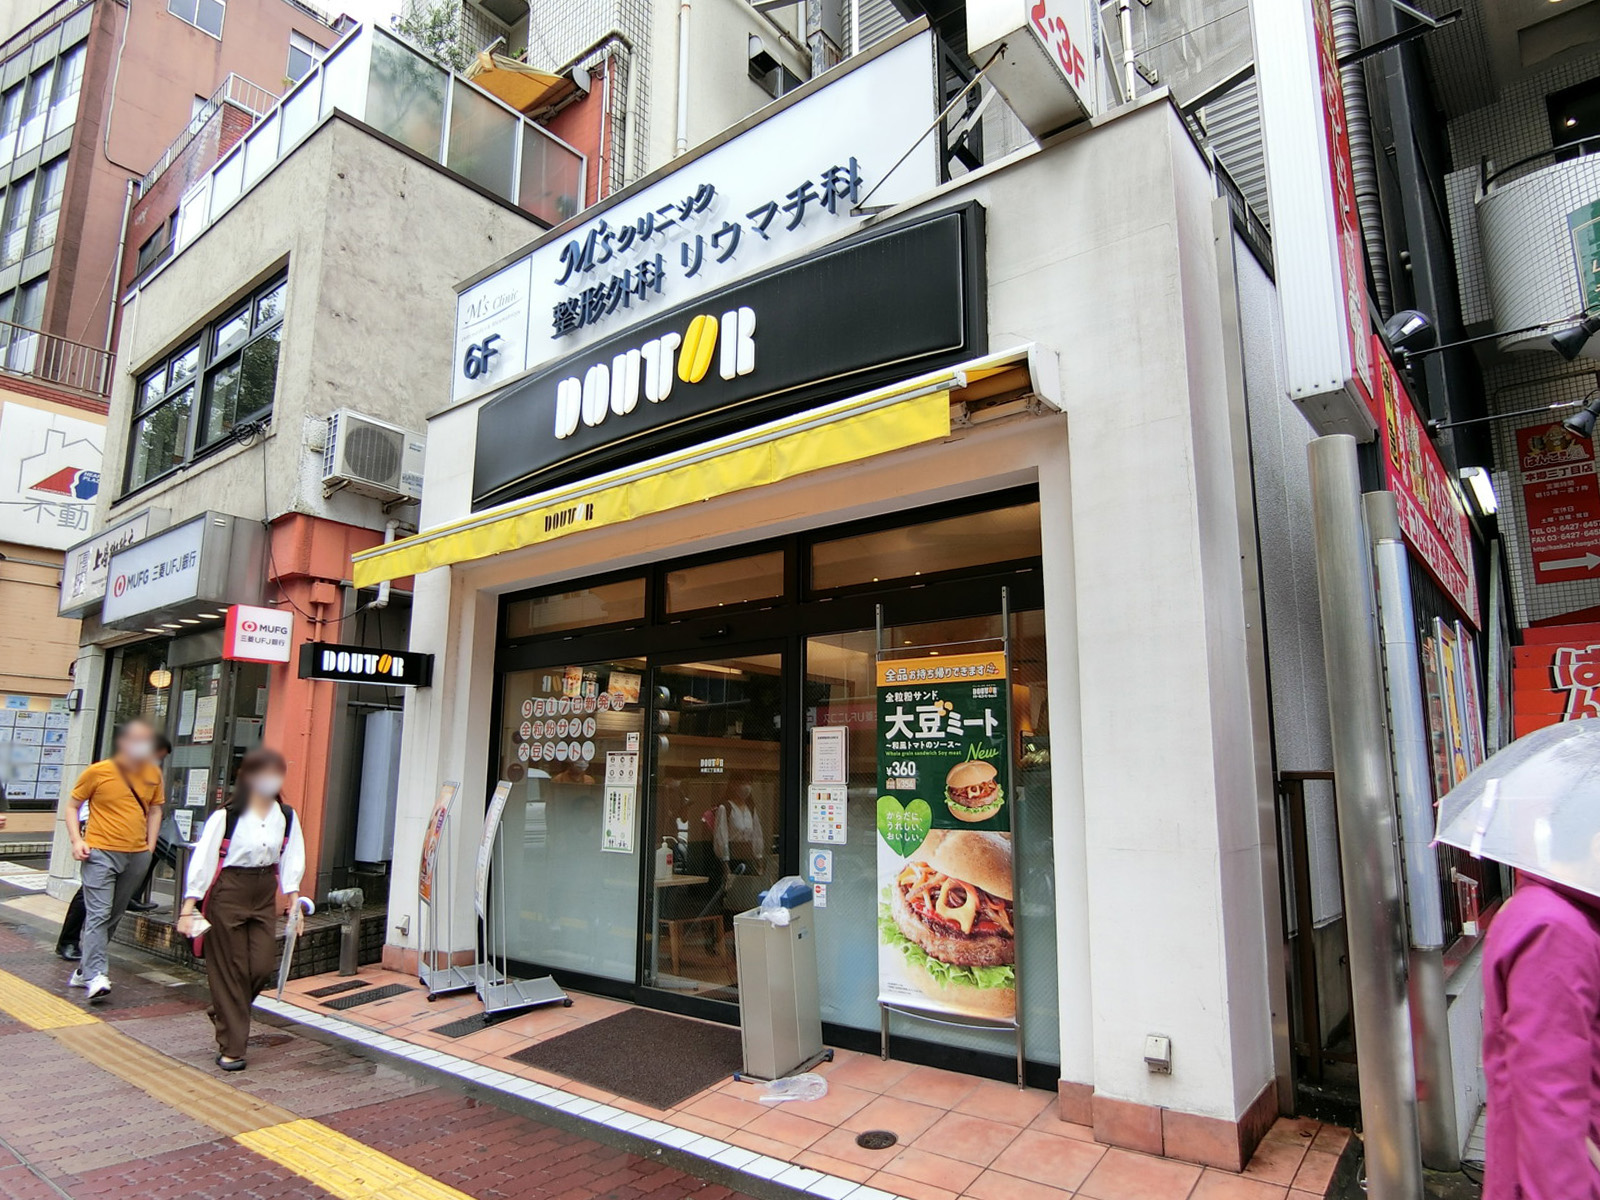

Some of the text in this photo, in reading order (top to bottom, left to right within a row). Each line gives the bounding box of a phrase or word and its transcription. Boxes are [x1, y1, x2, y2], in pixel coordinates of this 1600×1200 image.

[551, 156, 863, 340] 整形外科 リウマチ科
[463, 333, 501, 380] 6F
[554, 306, 757, 440] DOUTOR
[1525, 463, 1593, 482] 本郷三丁目店
[23, 497, 89, 531] 不動
[545, 502, 594, 532] DOUTOR
[1531, 528, 1545, 536] TEL
[1531, 536, 1546, 544] FAX
[126, 568, 149, 591] MUFG
[152, 550, 197, 582] 三菱UFJ銀行
[259, 624, 288, 635] MUFG
[240, 634, 285, 647] 三菱UFJ銀行
[322, 650, 405, 677] DOUTOR
[885, 664, 985, 683] 全品お持ち帰りできます
[523, 692, 625, 718] 9月17日新発売
[885, 690, 939, 703] 全粒粉サンド
[521, 719, 595, 738] 全粒粉サンド
[885, 706, 999, 740] 大豆ミート
[965, 742, 999, 763] New
[886, 761, 916, 776] ¥360
